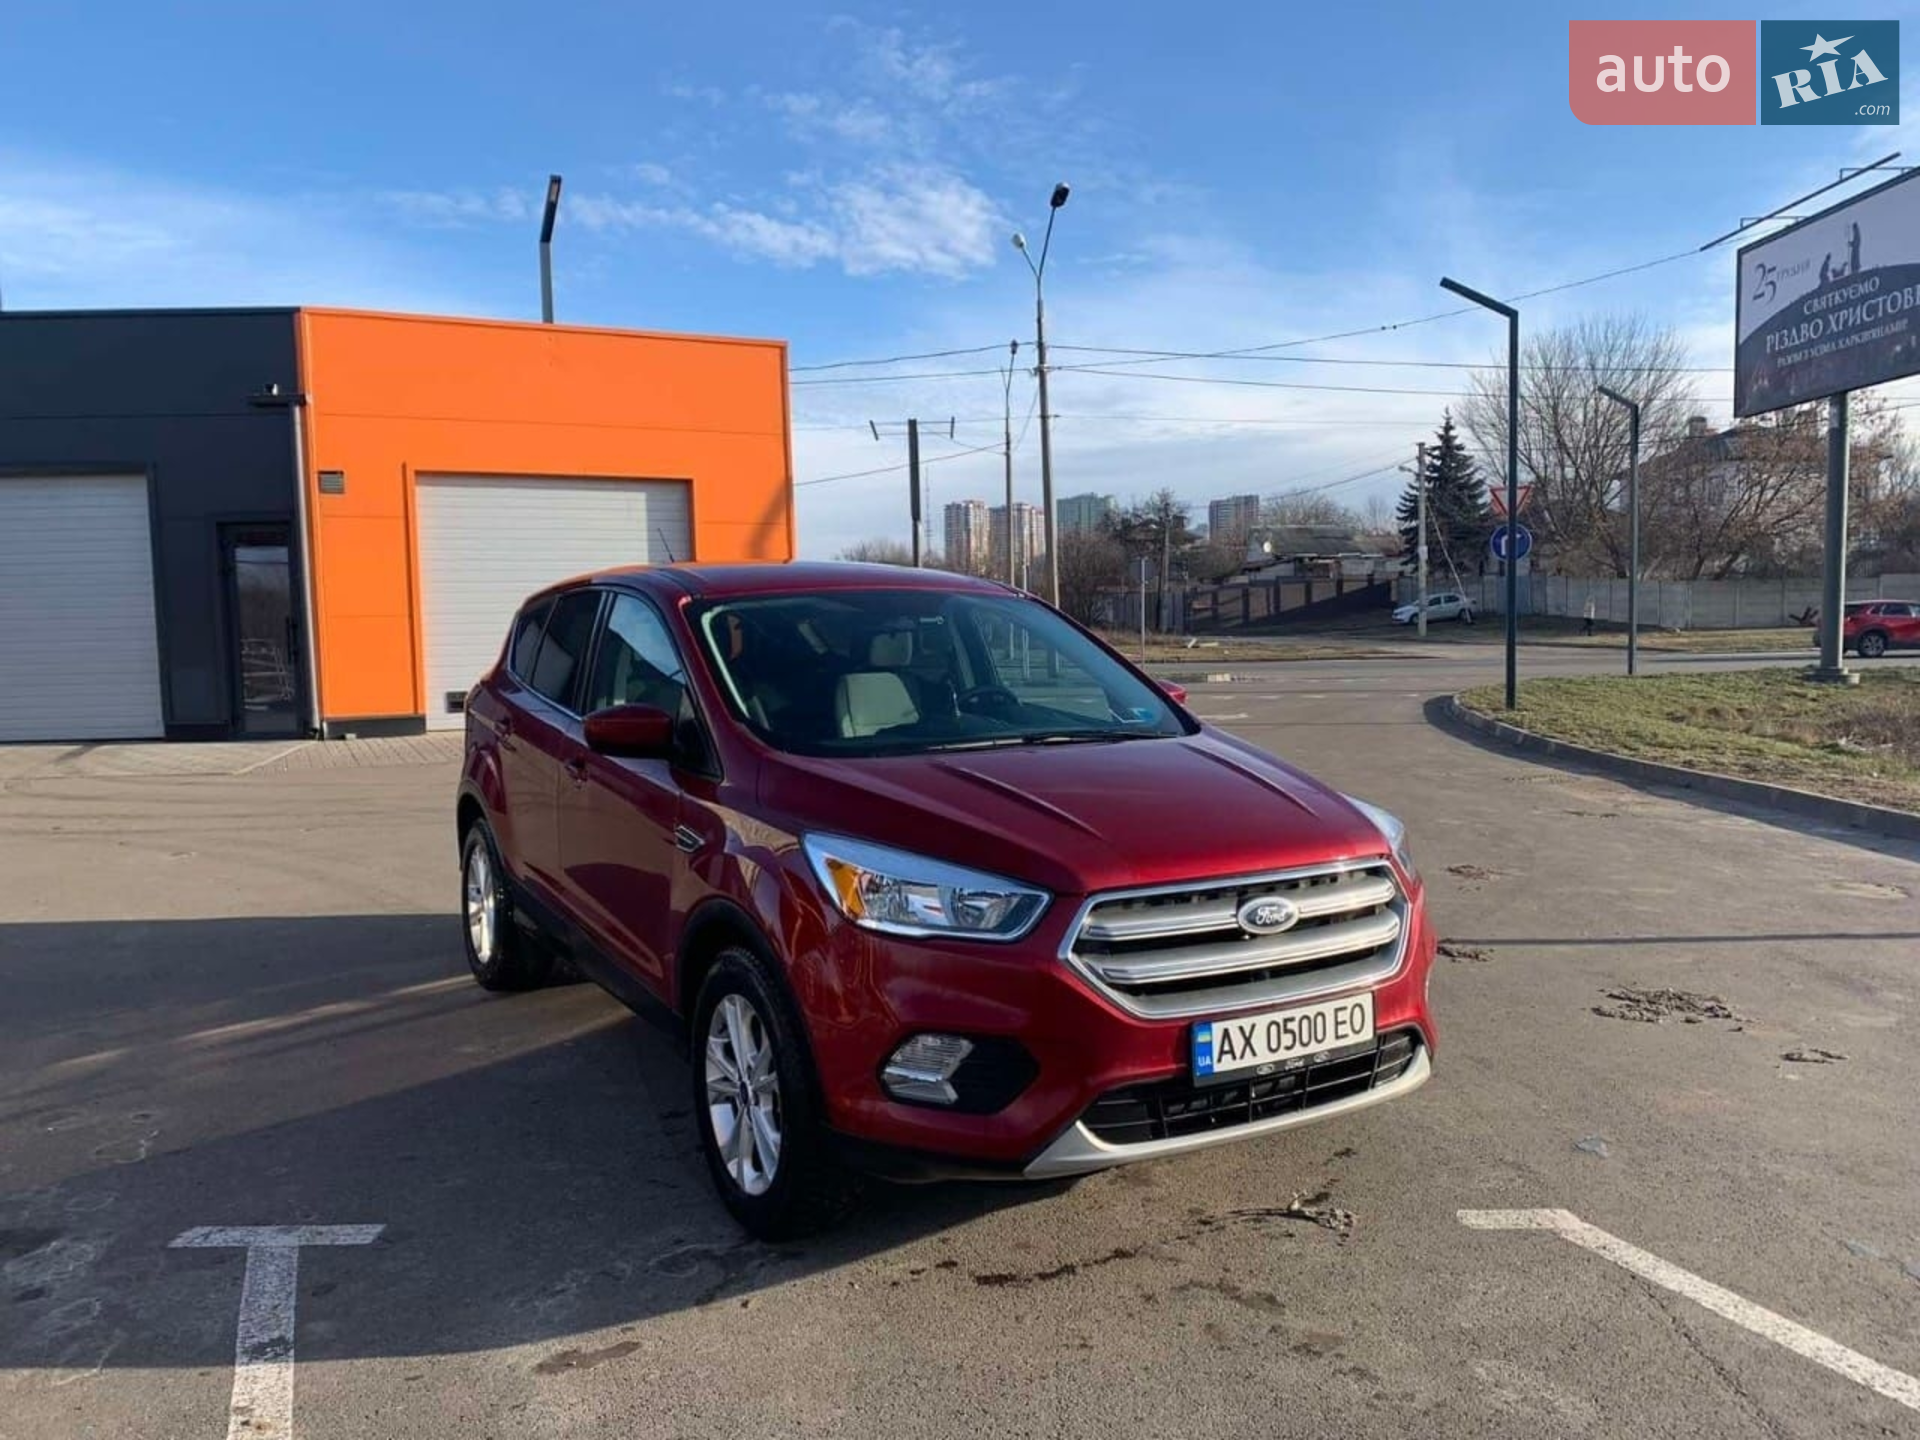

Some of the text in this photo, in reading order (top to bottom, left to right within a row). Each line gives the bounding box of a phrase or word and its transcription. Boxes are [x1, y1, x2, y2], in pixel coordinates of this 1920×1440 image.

[1752, 262, 1777, 305] 25
[1804, 276, 1880, 315] СВЯТКУЄМО
[1766, 318, 1823, 354] РІЗДВО
[1255, 905, 1286, 925] Ford
[1217, 1002, 1366, 1063] AX 0500 EO
[1198, 1056, 1212, 1067] UA
